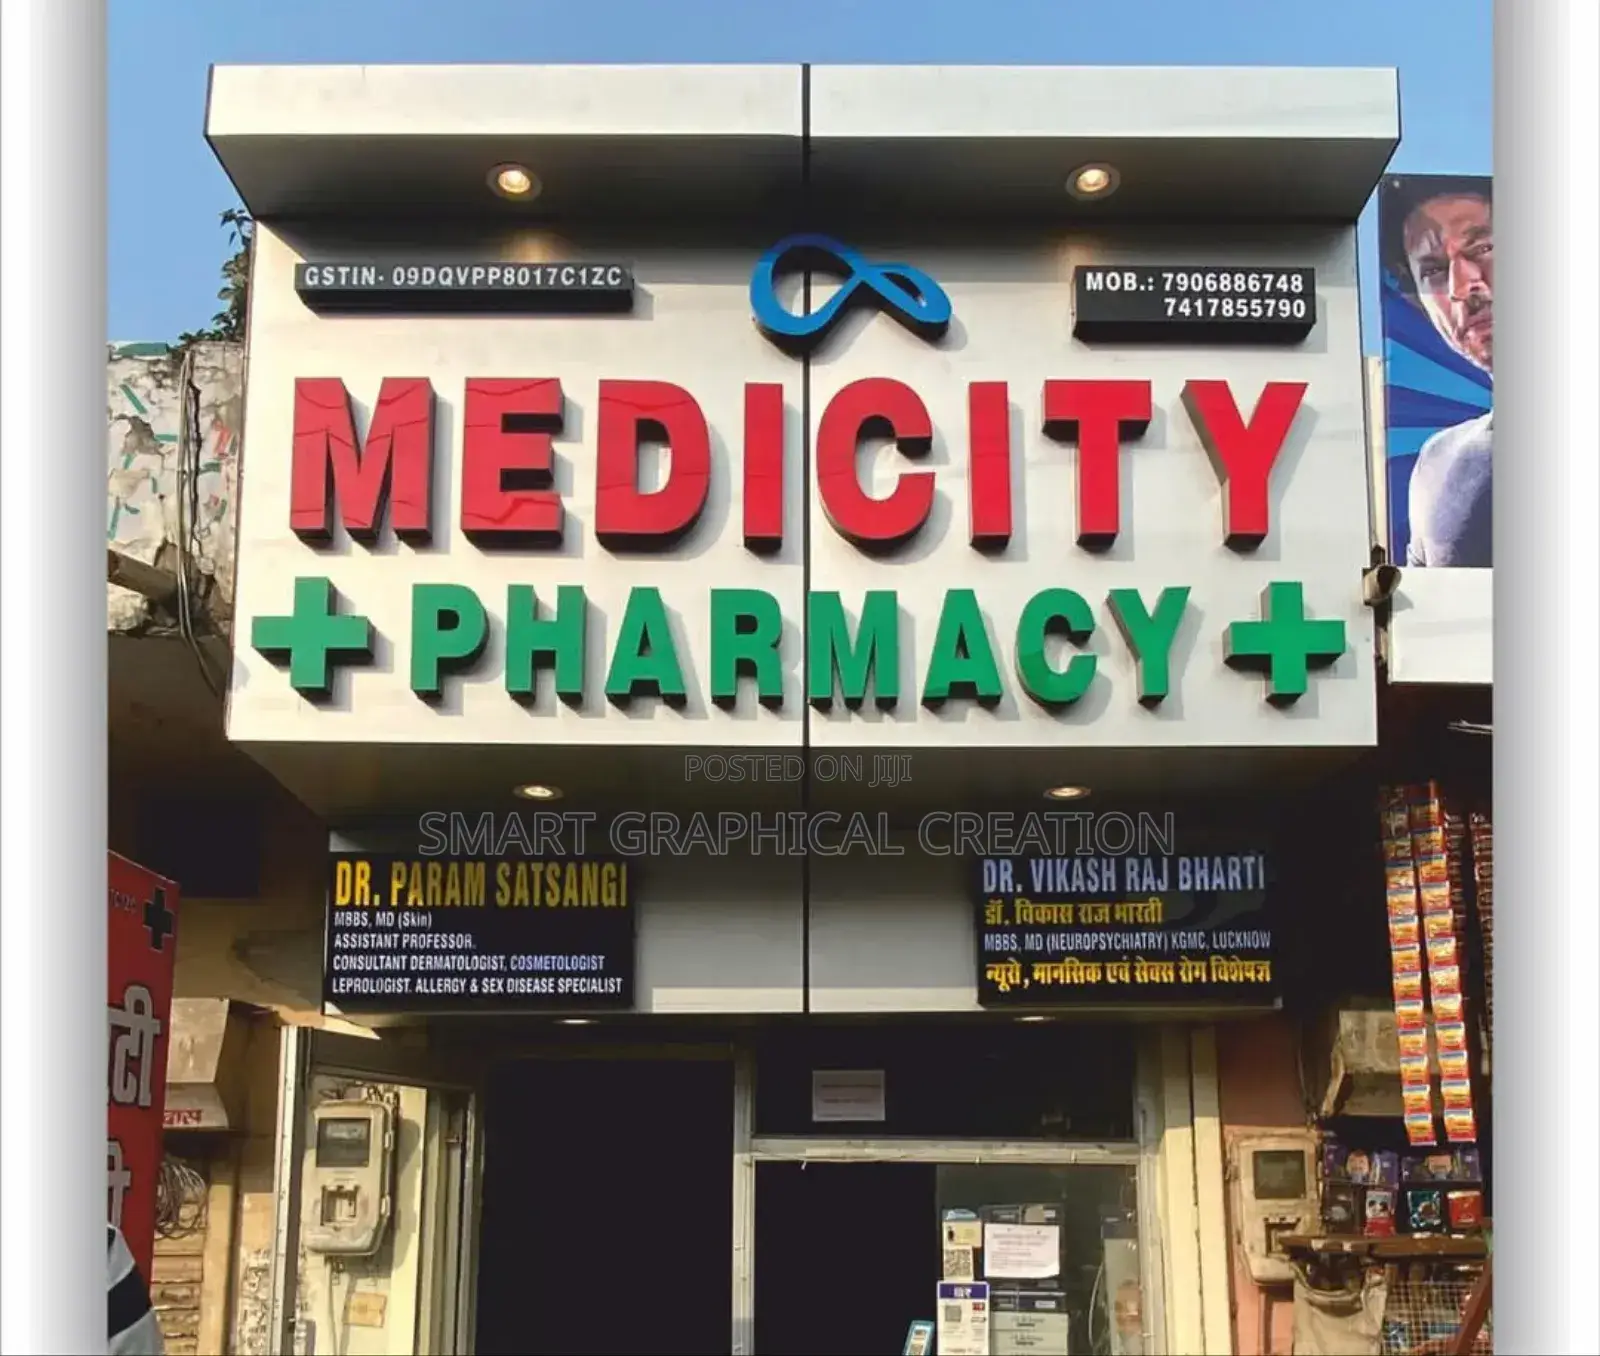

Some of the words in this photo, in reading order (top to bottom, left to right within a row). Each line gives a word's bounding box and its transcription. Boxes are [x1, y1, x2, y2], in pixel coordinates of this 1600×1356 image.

[392, 266, 622, 286] 09DQVPP8017C1ZC
[1085, 272, 1155, 292] MOB.:
[1162, 273, 1303, 293] 7906886748
[1164, 298, 1306, 318] 7417855790
[290, 376, 1309, 549] MEDICITY
[410, 584, 1192, 704] PHARMACY
[335, 861, 380, 906] DR.
[390, 861, 486, 907] PARAM
[496, 861, 627, 907] SATSANGI
[983, 858, 1024, 893] DR.
[1030, 857, 1117, 893] VIKASH
[1125, 856, 1169, 892] RAJ
[1178, 854, 1265, 891] BHARTI
[375, 911, 395, 927] MD
[398, 911, 433, 929] (Skin)
[1014, 897, 1075, 925] विकास
[1077, 902, 1111, 925] राज
[1113, 896, 1163, 924] भारती
[334, 933, 400, 949] ASSISTANT
[1024, 932, 1044, 950] MD
[1046, 931, 1169, 955] (NEUROPSYCHIATRY)
[1212, 930, 1272, 949] LUCKNOW
[332, 954, 408, 971] CONSULTANT
[510, 954, 606, 971] COSMETOLOGIST
[1031, 956, 1103, 984] मानसिक
[1104, 954, 1132, 984] एवं
[1178, 955, 1208, 984] रोग
[415, 977, 467, 994] ALLERGY
[469, 977, 479, 993] &
[481, 977, 505, 994] SEX
[506, 977, 555, 994] DISEASE
[557, 977, 623, 994] SPECIALIST
